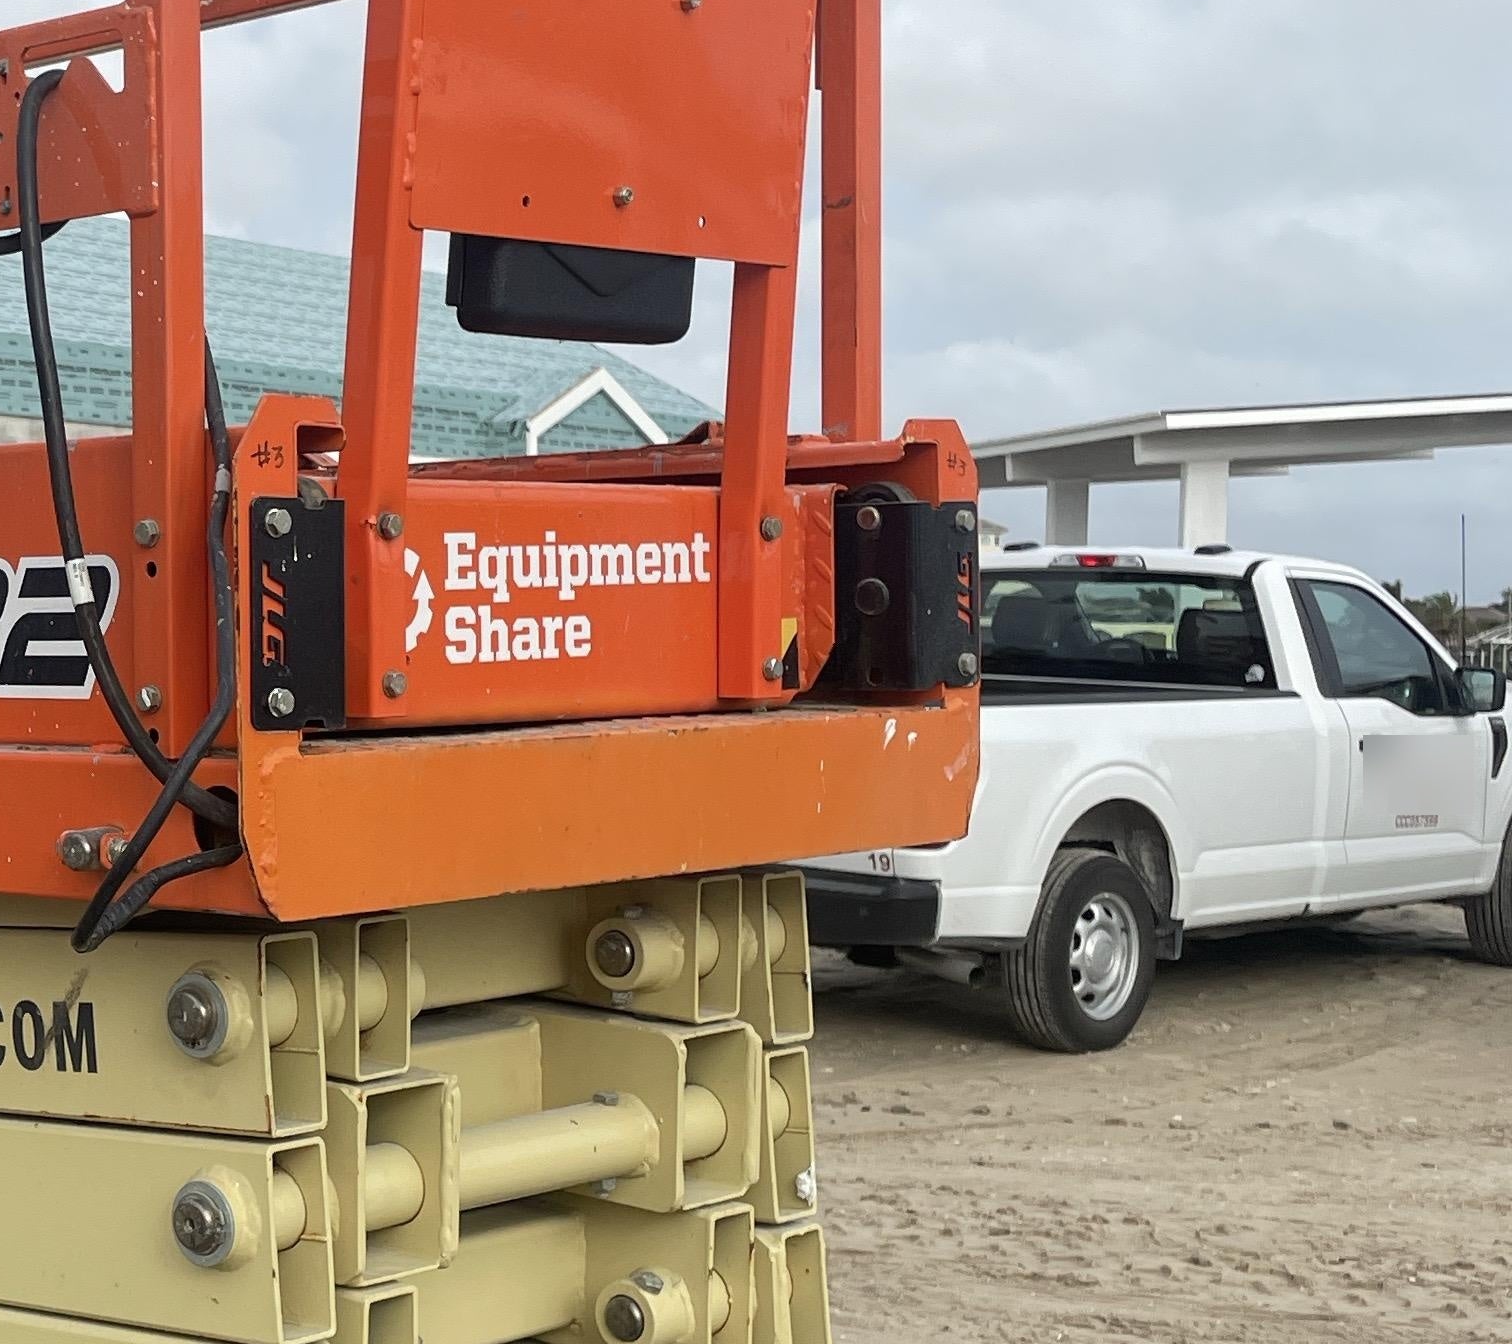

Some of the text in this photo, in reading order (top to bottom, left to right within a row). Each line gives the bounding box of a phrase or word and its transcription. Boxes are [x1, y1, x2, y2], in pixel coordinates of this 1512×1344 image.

[442, 530, 712, 604] Equipment
[956, 552, 973, 635] JLG
[261, 559, 287, 668] JLG
[444, 604, 592, 665] Share
[867, 852, 890, 873] 19
